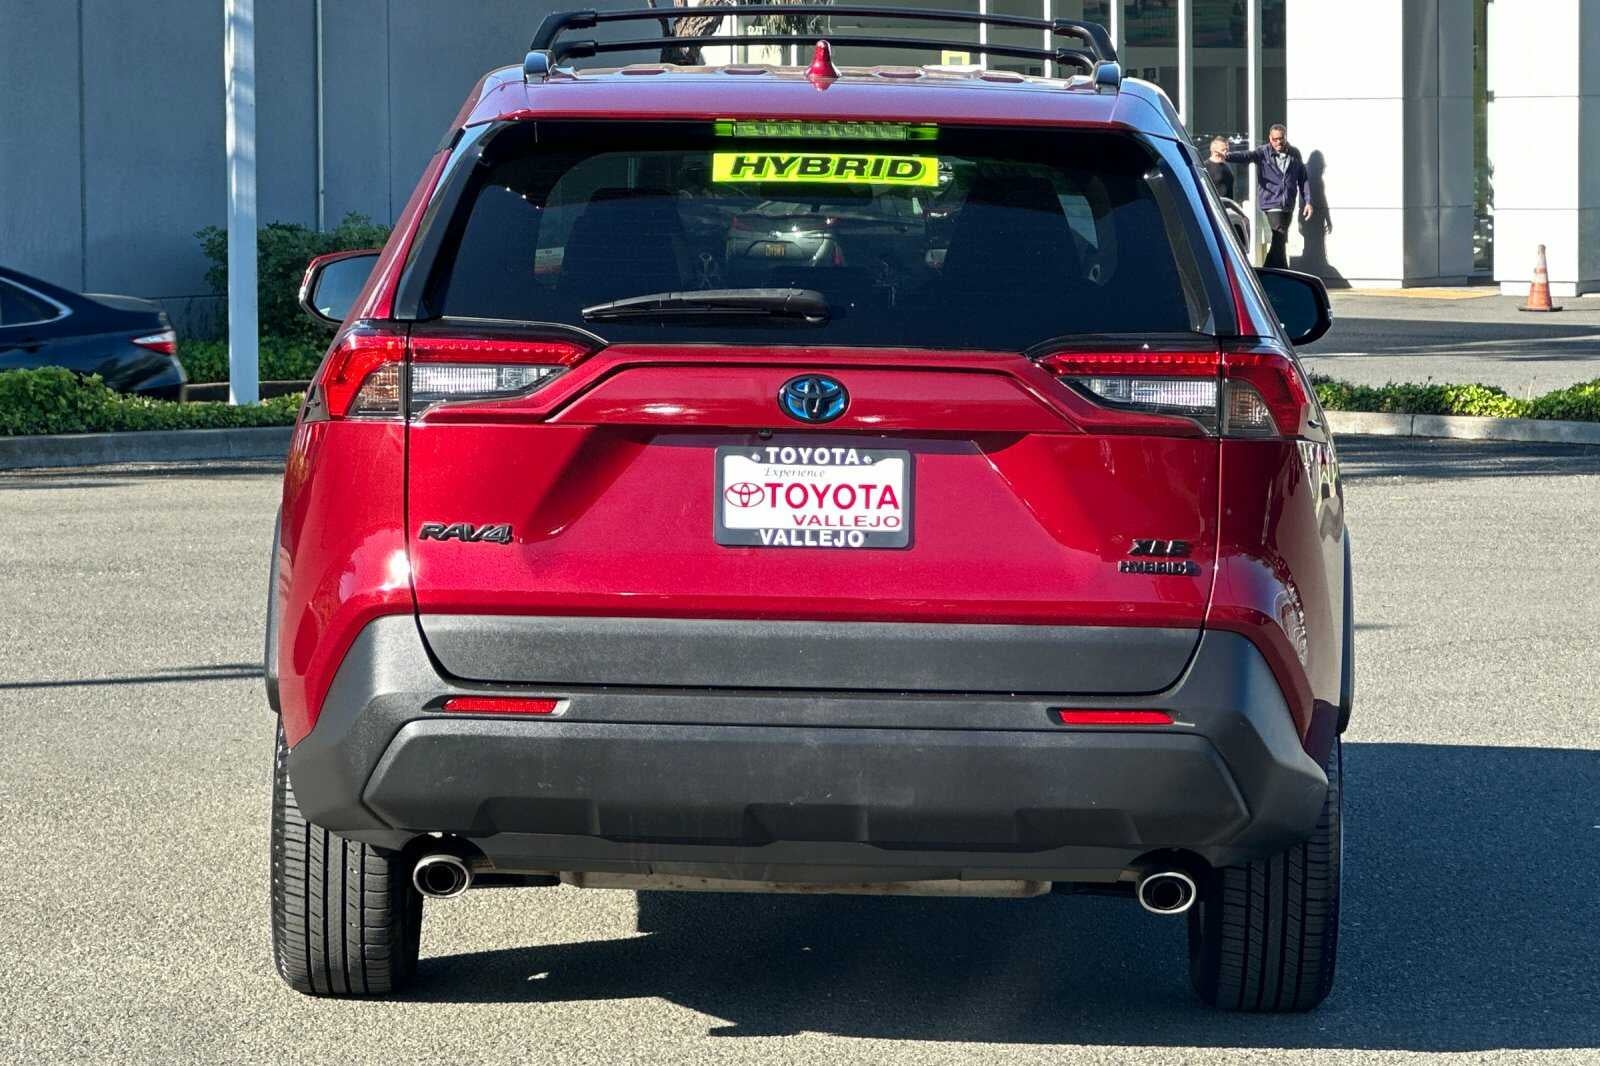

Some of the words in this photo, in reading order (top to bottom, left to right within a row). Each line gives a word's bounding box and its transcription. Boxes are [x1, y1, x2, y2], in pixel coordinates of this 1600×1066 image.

[730, 156, 926, 181] HYBRID
[765, 446, 861, 465] TOYOTA
[764, 467, 825, 478] Experience
[764, 482, 900, 509] TOYOTA
[792, 514, 901, 528] VALLEJO
[419, 522, 513, 544] RAV4
[759, 529, 865, 547] VALLEJO
